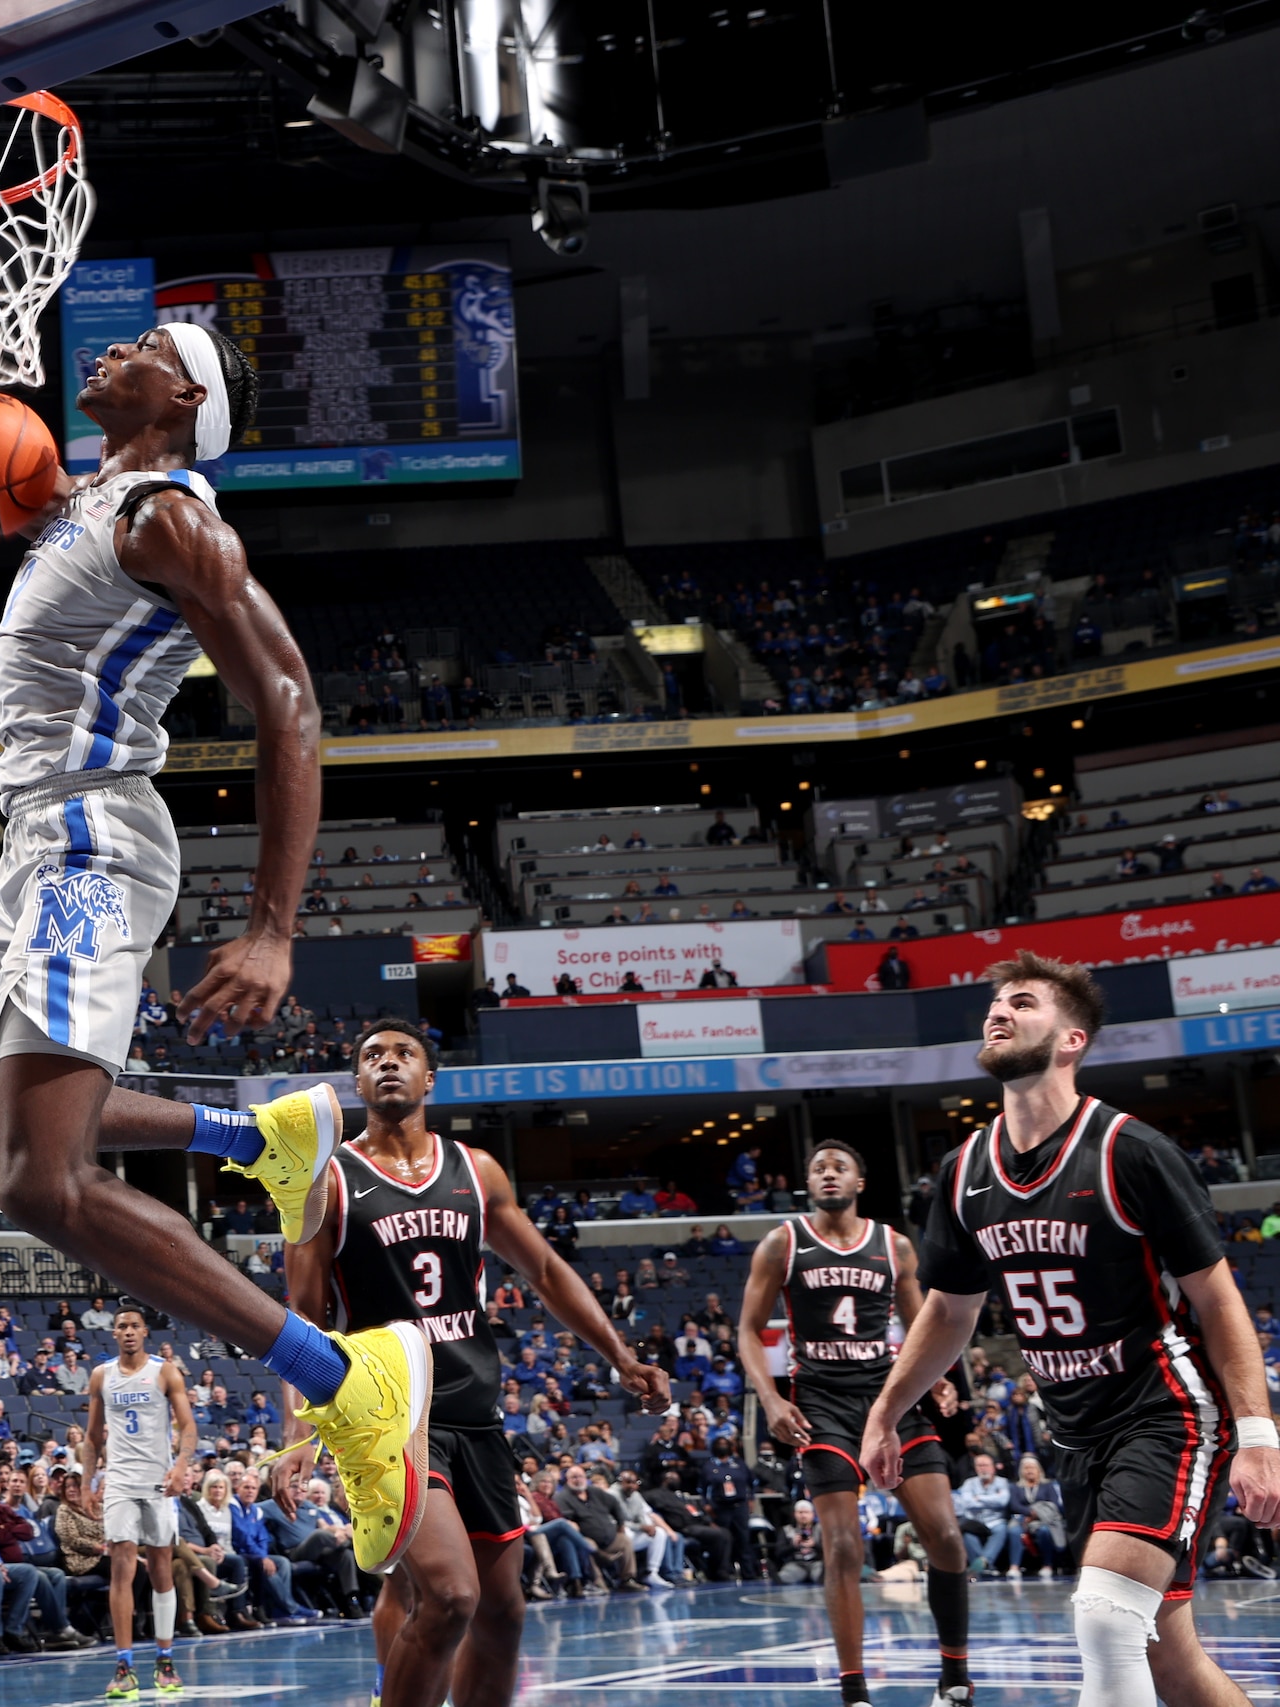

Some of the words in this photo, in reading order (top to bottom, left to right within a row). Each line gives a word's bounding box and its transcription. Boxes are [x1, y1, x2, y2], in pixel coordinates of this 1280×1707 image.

[75, 266, 135, 284] Ticket
[65, 286, 152, 305] Smarter
[293, 460, 355, 475] PARTNER
[558, 949, 616, 966] Score
[618, 945, 676, 967] points
[682, 943, 723, 959] with
[388, 965, 413, 978] 112A
[552, 972, 584, 988] te
[1242, 974, 1280, 990] FanD
[701, 1026, 758, 1038] FanDeck
[1204, 1013, 1280, 1047] LIFE
[863, 1054, 904, 1071] Clinic
[453, 1071, 523, 1098] LIFE
[535, 1069, 567, 1094] IS
[371, 1208, 470, 1248] WESTERN
[976, 1218, 1089, 1261] WESTERN
[411, 1249, 443, 1308] 3
[801, 1265, 887, 1293] WESTERN
[832, 1295, 858, 1336] 4
[1002, 1268, 1088, 1339] 55
[804, 1340, 886, 1361] KENTUCKY
[1021, 1339, 1125, 1383] ENTUCKY
[111, 1391, 150, 1406] Tigers
[125, 1409, 139, 1435] 3
